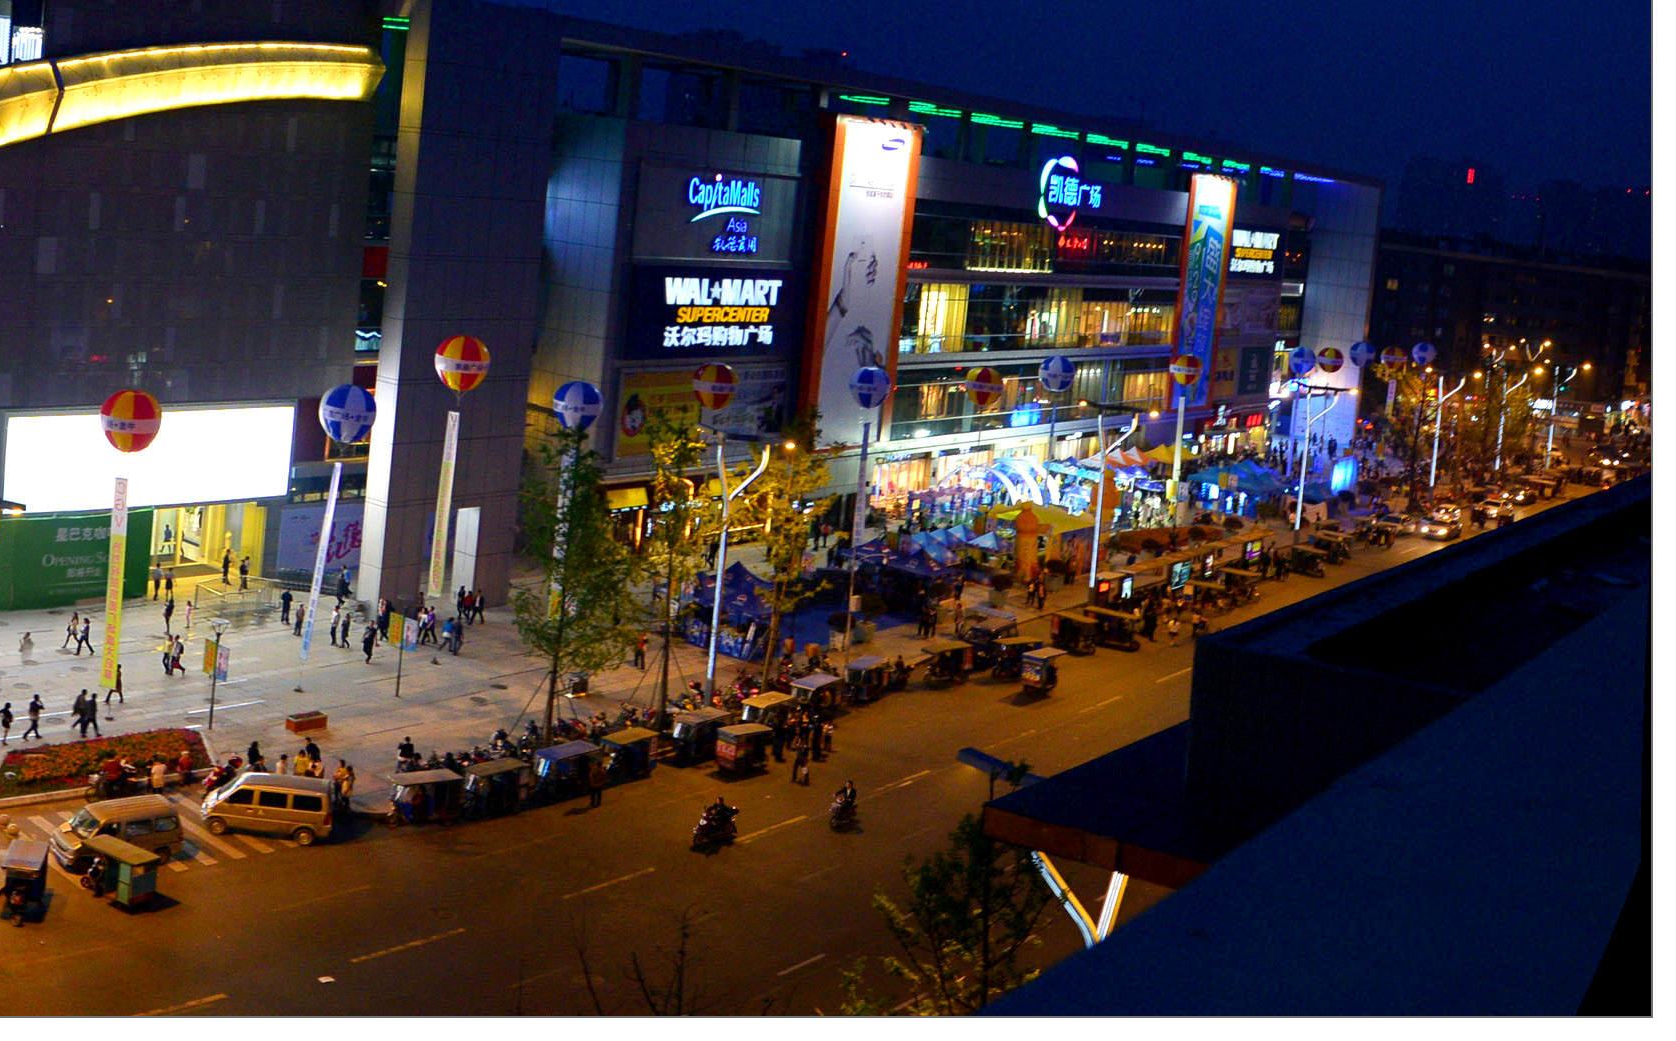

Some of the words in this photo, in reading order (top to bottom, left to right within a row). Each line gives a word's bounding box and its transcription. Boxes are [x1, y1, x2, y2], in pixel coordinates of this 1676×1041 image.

[689, 173, 760, 211] CapitaMalls
[1048, 174, 1102, 208] 凯德广场
[727, 217, 748, 233] Asia
[676, 306, 770, 323] SUPERCENTER
[663, 325, 773, 346] 沃尔玛购物广场
